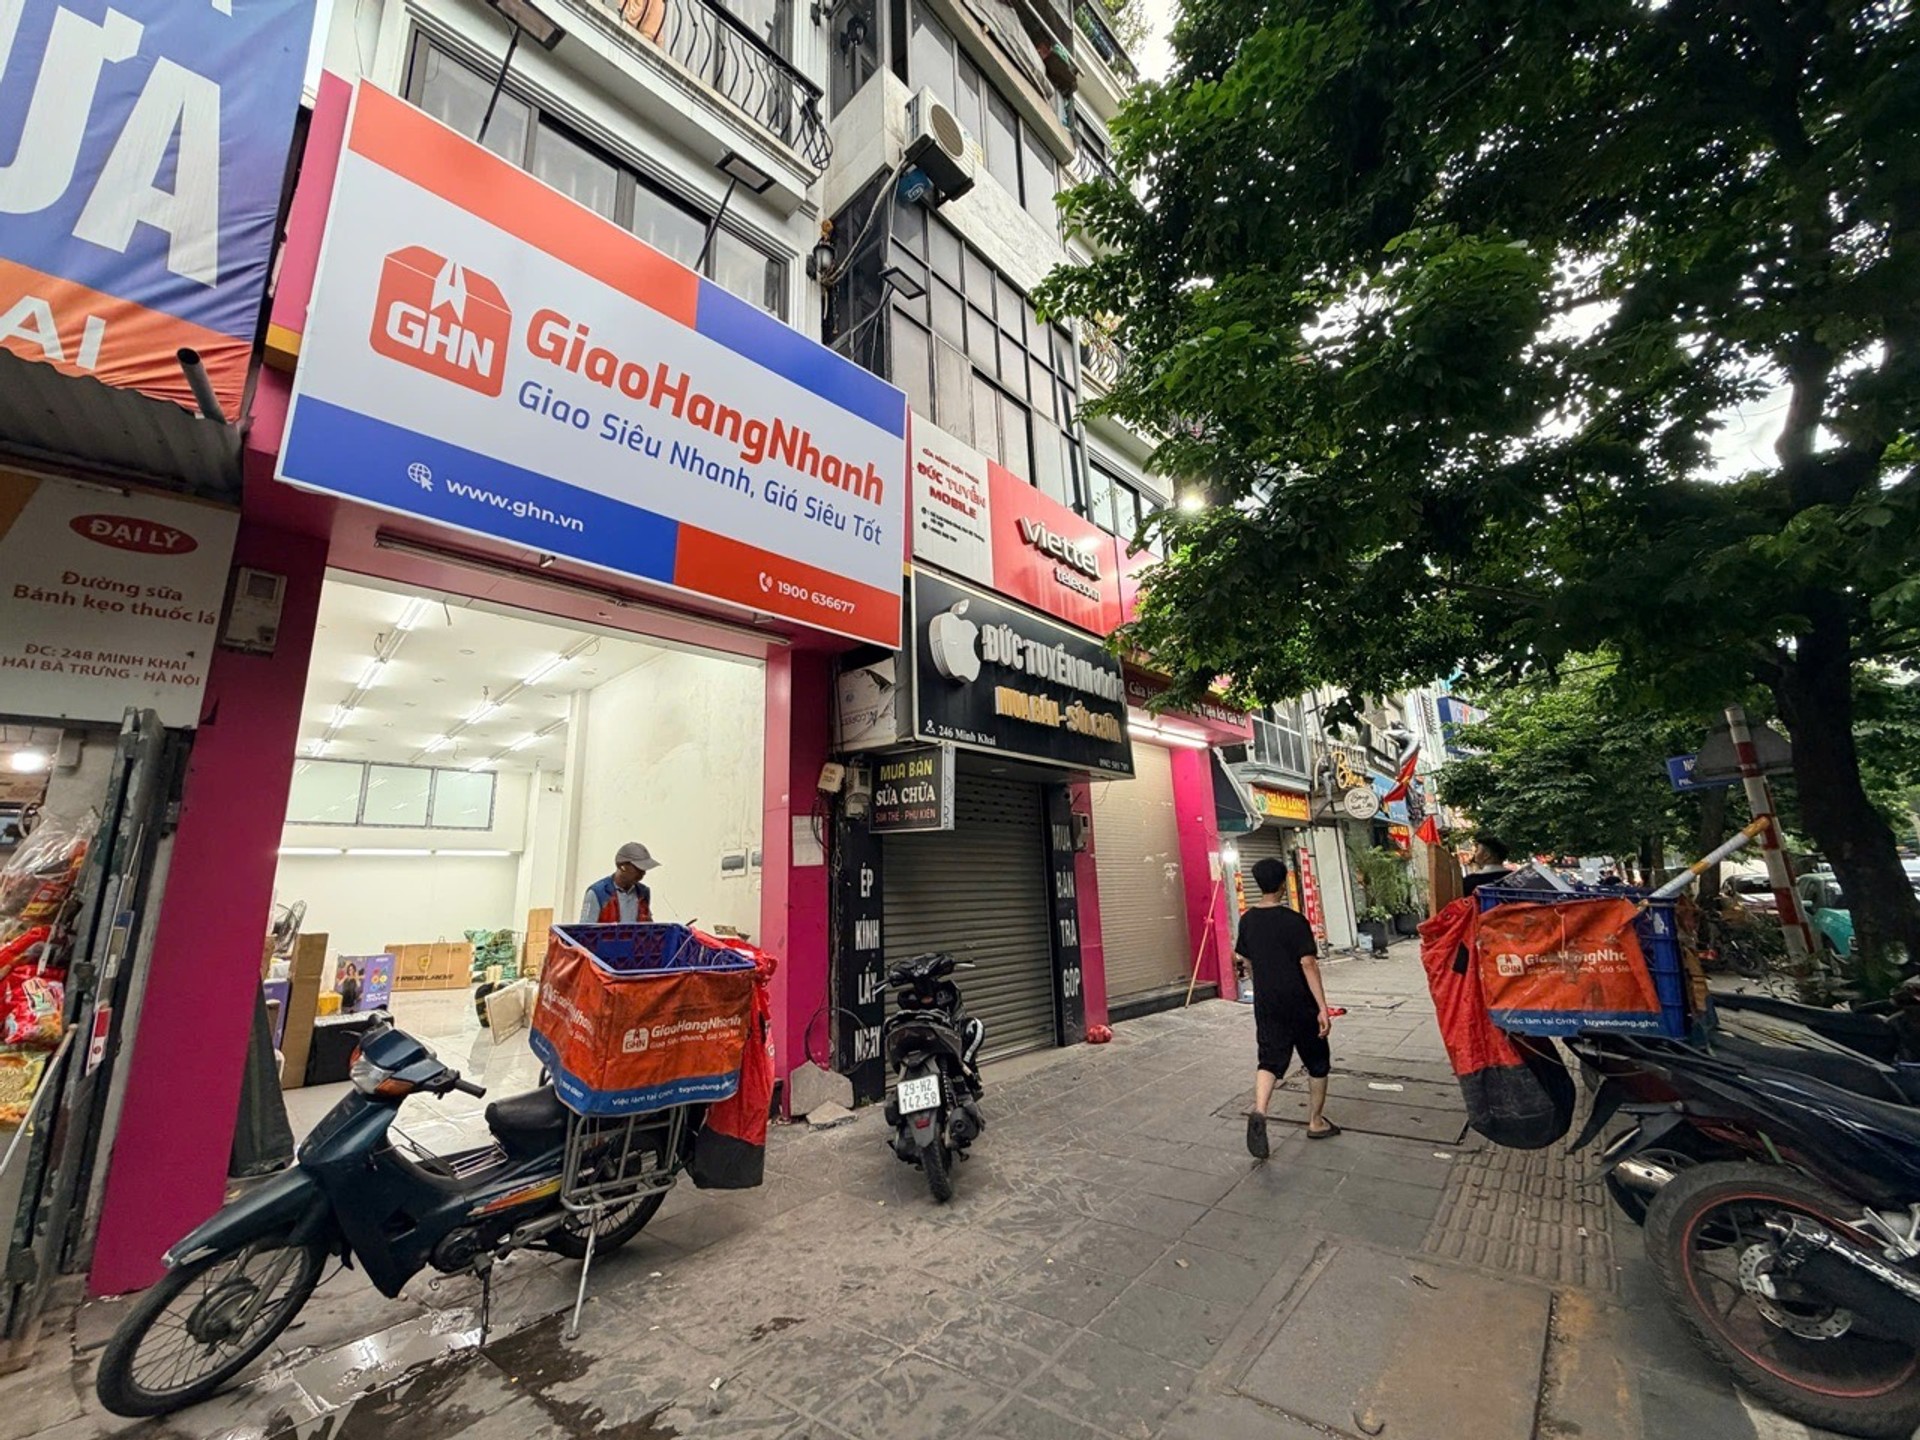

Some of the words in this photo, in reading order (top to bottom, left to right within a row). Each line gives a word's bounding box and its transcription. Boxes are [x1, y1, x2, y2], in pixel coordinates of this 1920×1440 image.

[386, 301, 494, 378] GHN
[527, 309, 884, 506] GiaoHangNhanh
[518, 380, 590, 430] Giao
[600, 413, 662, 459] Siêu
[669, 440, 755, 498] Nhanh,
[764, 480, 797, 512] Giá
[804, 497, 846, 531] Siêu
[854, 515, 882, 546] Tốt
[446, 478, 584, 532] www.ghn.vn
[929, 485, 977, 520] MOBILE
[90, 518, 143, 545] ĐẠI
[149, 529, 181, 549] LÝ
[61, 571, 141, 598] Đường
[145, 586, 183, 601] sữa
[777, 580, 808, 600] 1900
[811, 592, 855, 614] 636677
[13, 583, 76, 606] Bánh
[83, 594, 125, 614] kẹo
[131, 601, 192, 622] thuốc
[197, 610, 216, 625] lá
[24, 643, 56, 656] ĐC:
[61, 648, 92, 661] 248
[97, 651, 144, 667] MINH
[147, 656, 188, 671] KHAI
[981, 623, 1024, 670] ĐỨC
[2, 656, 36, 670] HAI
[40, 655, 64, 673] BÀ
[71, 662, 130, 680] TRƯNG
[143, 668, 166, 683] HÀ
[171, 671, 200, 687] NỘI
[939, 724, 954, 738] 246
[955, 728, 976, 742] Minh
[978, 732, 996, 746] Khai
[880, 763, 905, 780] MUA
[908, 756, 933, 777] BÁN
[876, 783, 898, 806] SỬA
[901, 781, 936, 803] CHỮA
[860, 862, 874, 898] ÉP
[1056, 865, 1075, 898] BÁN
[855, 913, 880, 950] KÍNH
[1063, 961, 1080, 998] GÓP
[625, 1039, 645, 1051] GHN
[651, 1014, 741, 1038] GiaoHangNhanh
